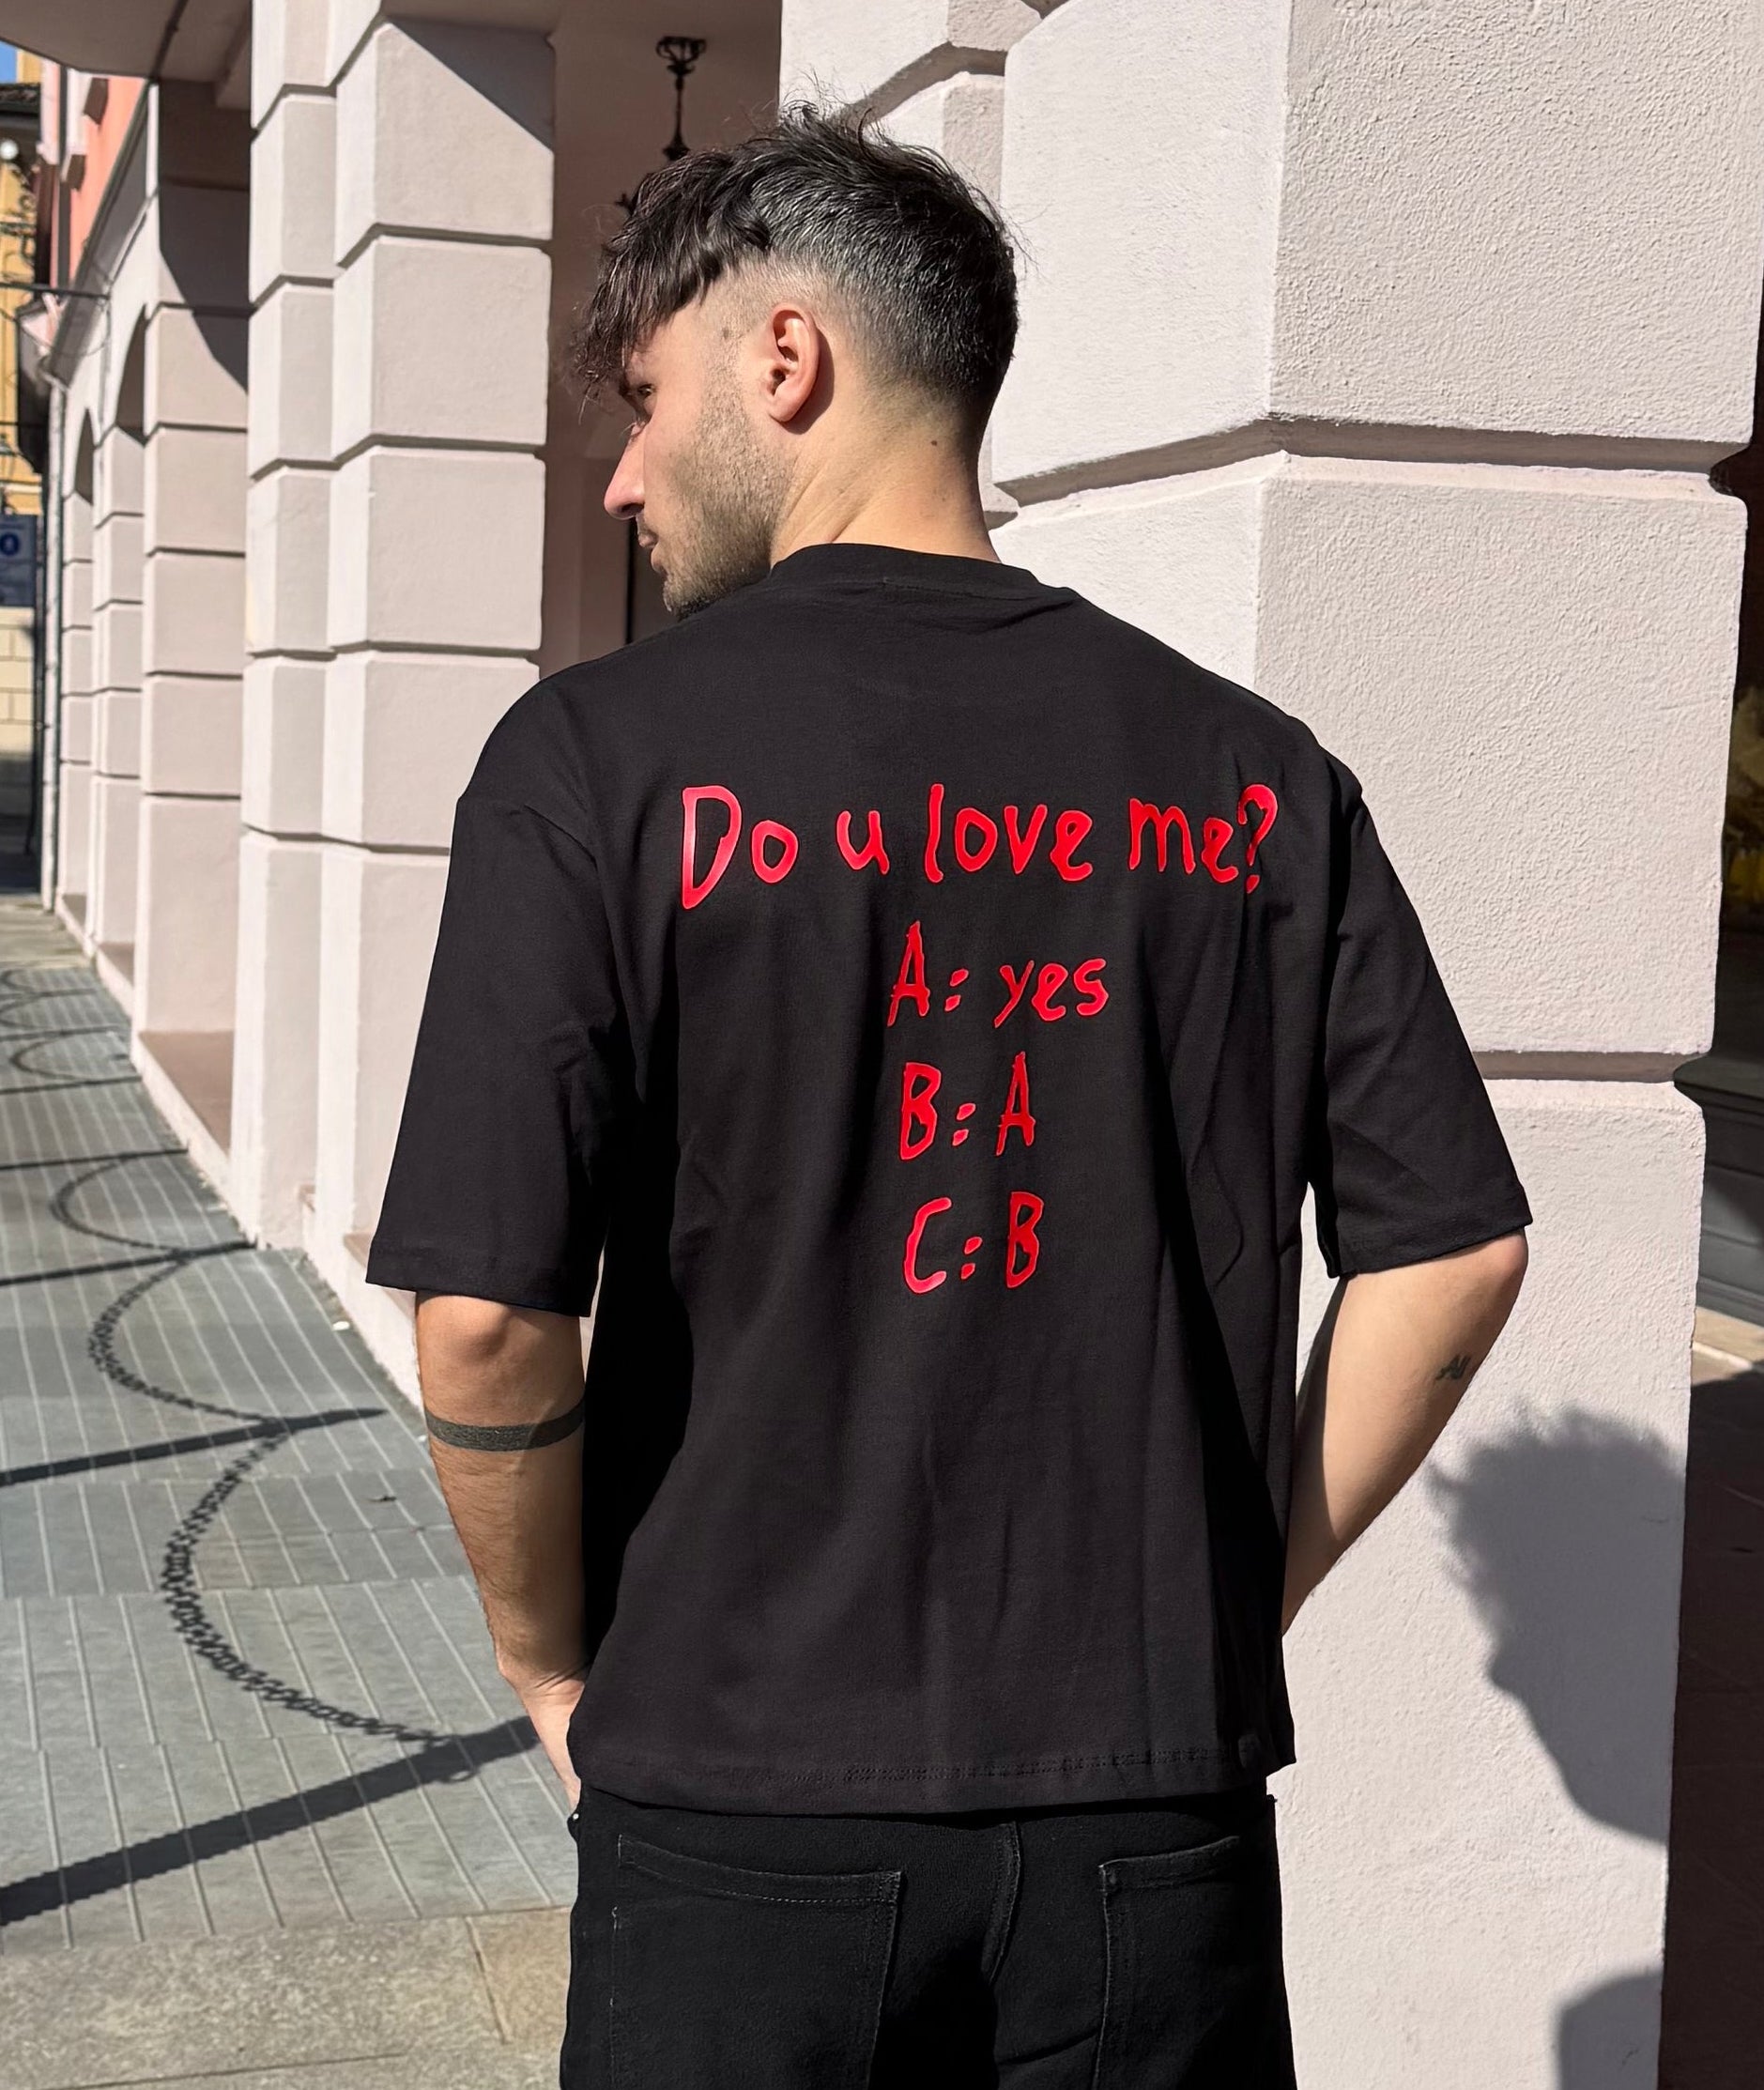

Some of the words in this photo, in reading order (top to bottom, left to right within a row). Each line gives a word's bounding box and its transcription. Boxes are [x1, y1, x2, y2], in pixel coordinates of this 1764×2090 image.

[681, 784, 799, 910] Do
[836, 809, 890, 875] u
[924, 782, 1094, 884] love
[1127, 783, 1280, 894] me?
[887, 921, 969, 1028] A:
[993, 958, 1110, 1029] yes
[898, 1061, 976, 1161] B:
[995, 1051, 1036, 1157] A
[902, 1196, 983, 1295] C:
[1005, 1191, 1045, 1289] B
